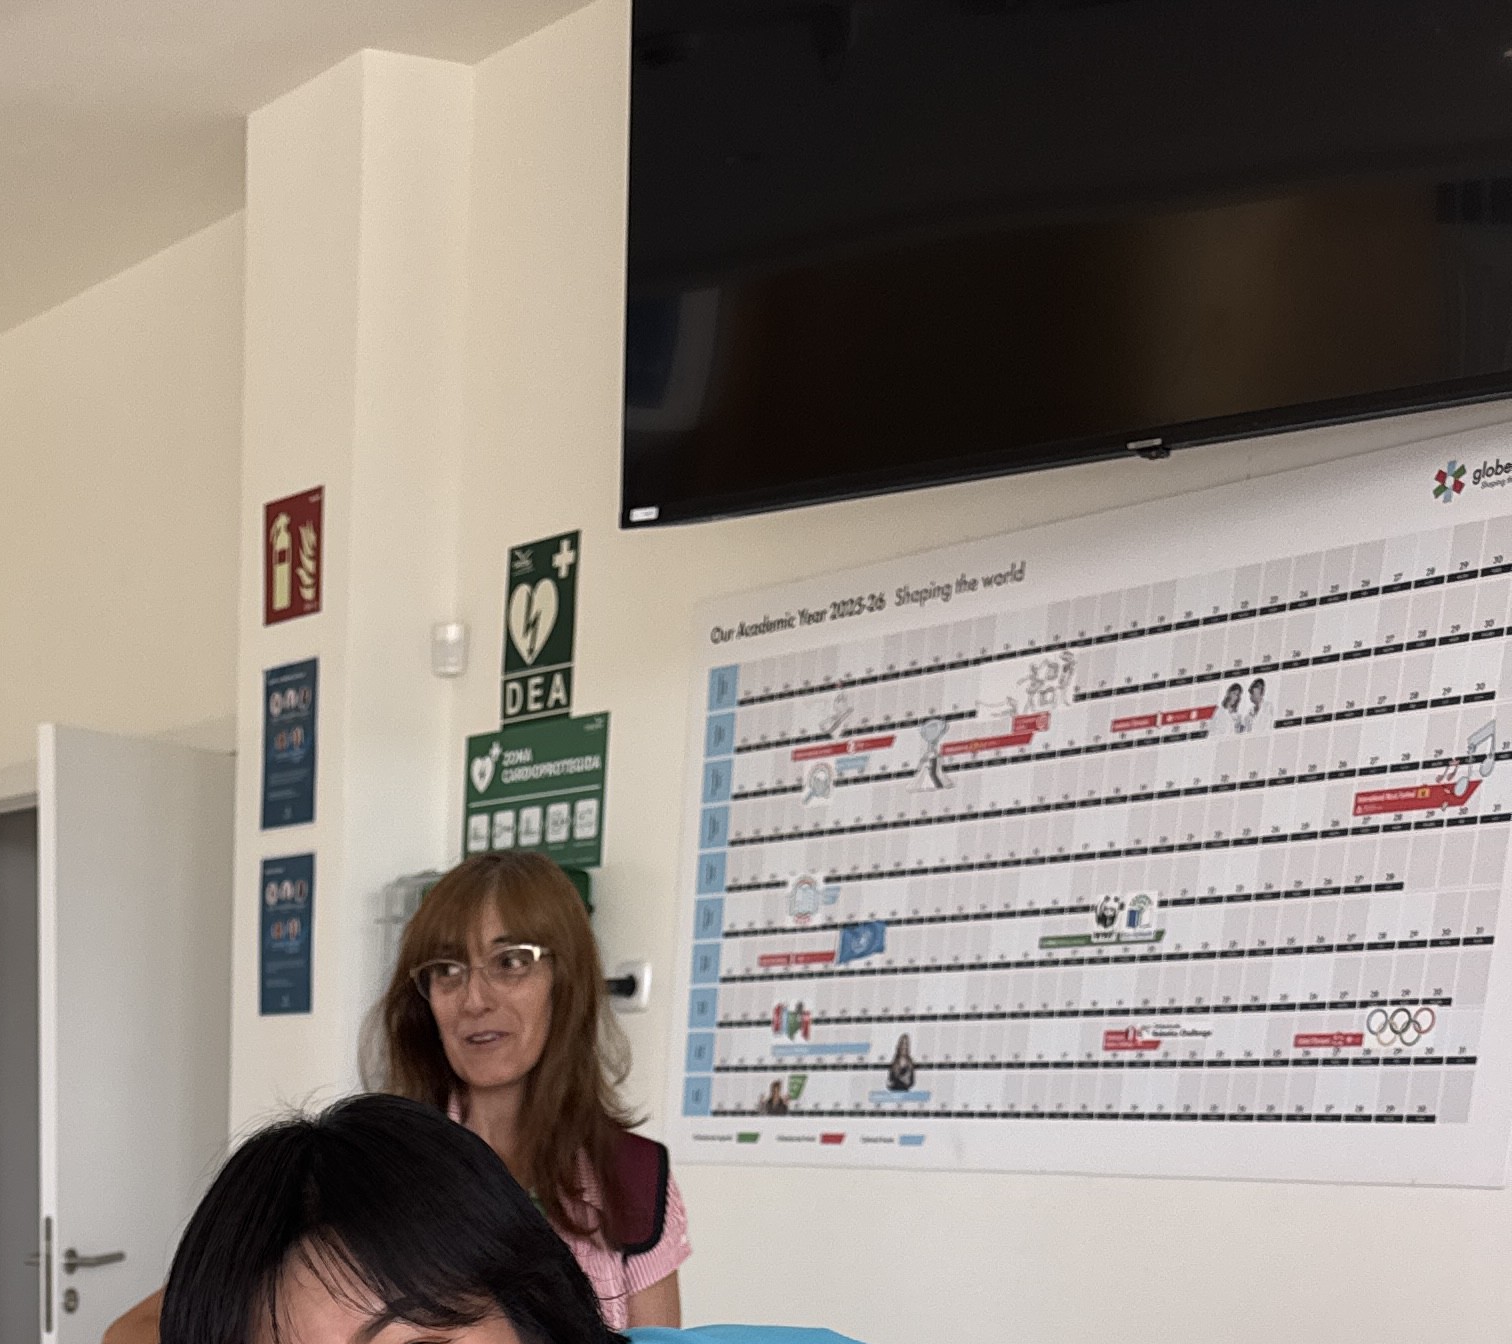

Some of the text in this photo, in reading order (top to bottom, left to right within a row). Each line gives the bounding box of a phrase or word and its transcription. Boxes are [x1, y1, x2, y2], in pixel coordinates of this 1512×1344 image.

[894, 559, 1026, 608] Shaping the world
[710, 625, 735, 644] Our
[737, 612, 797, 639] Academic
[797, 608, 827, 627] Year
[505, 672, 567, 716] DEA
